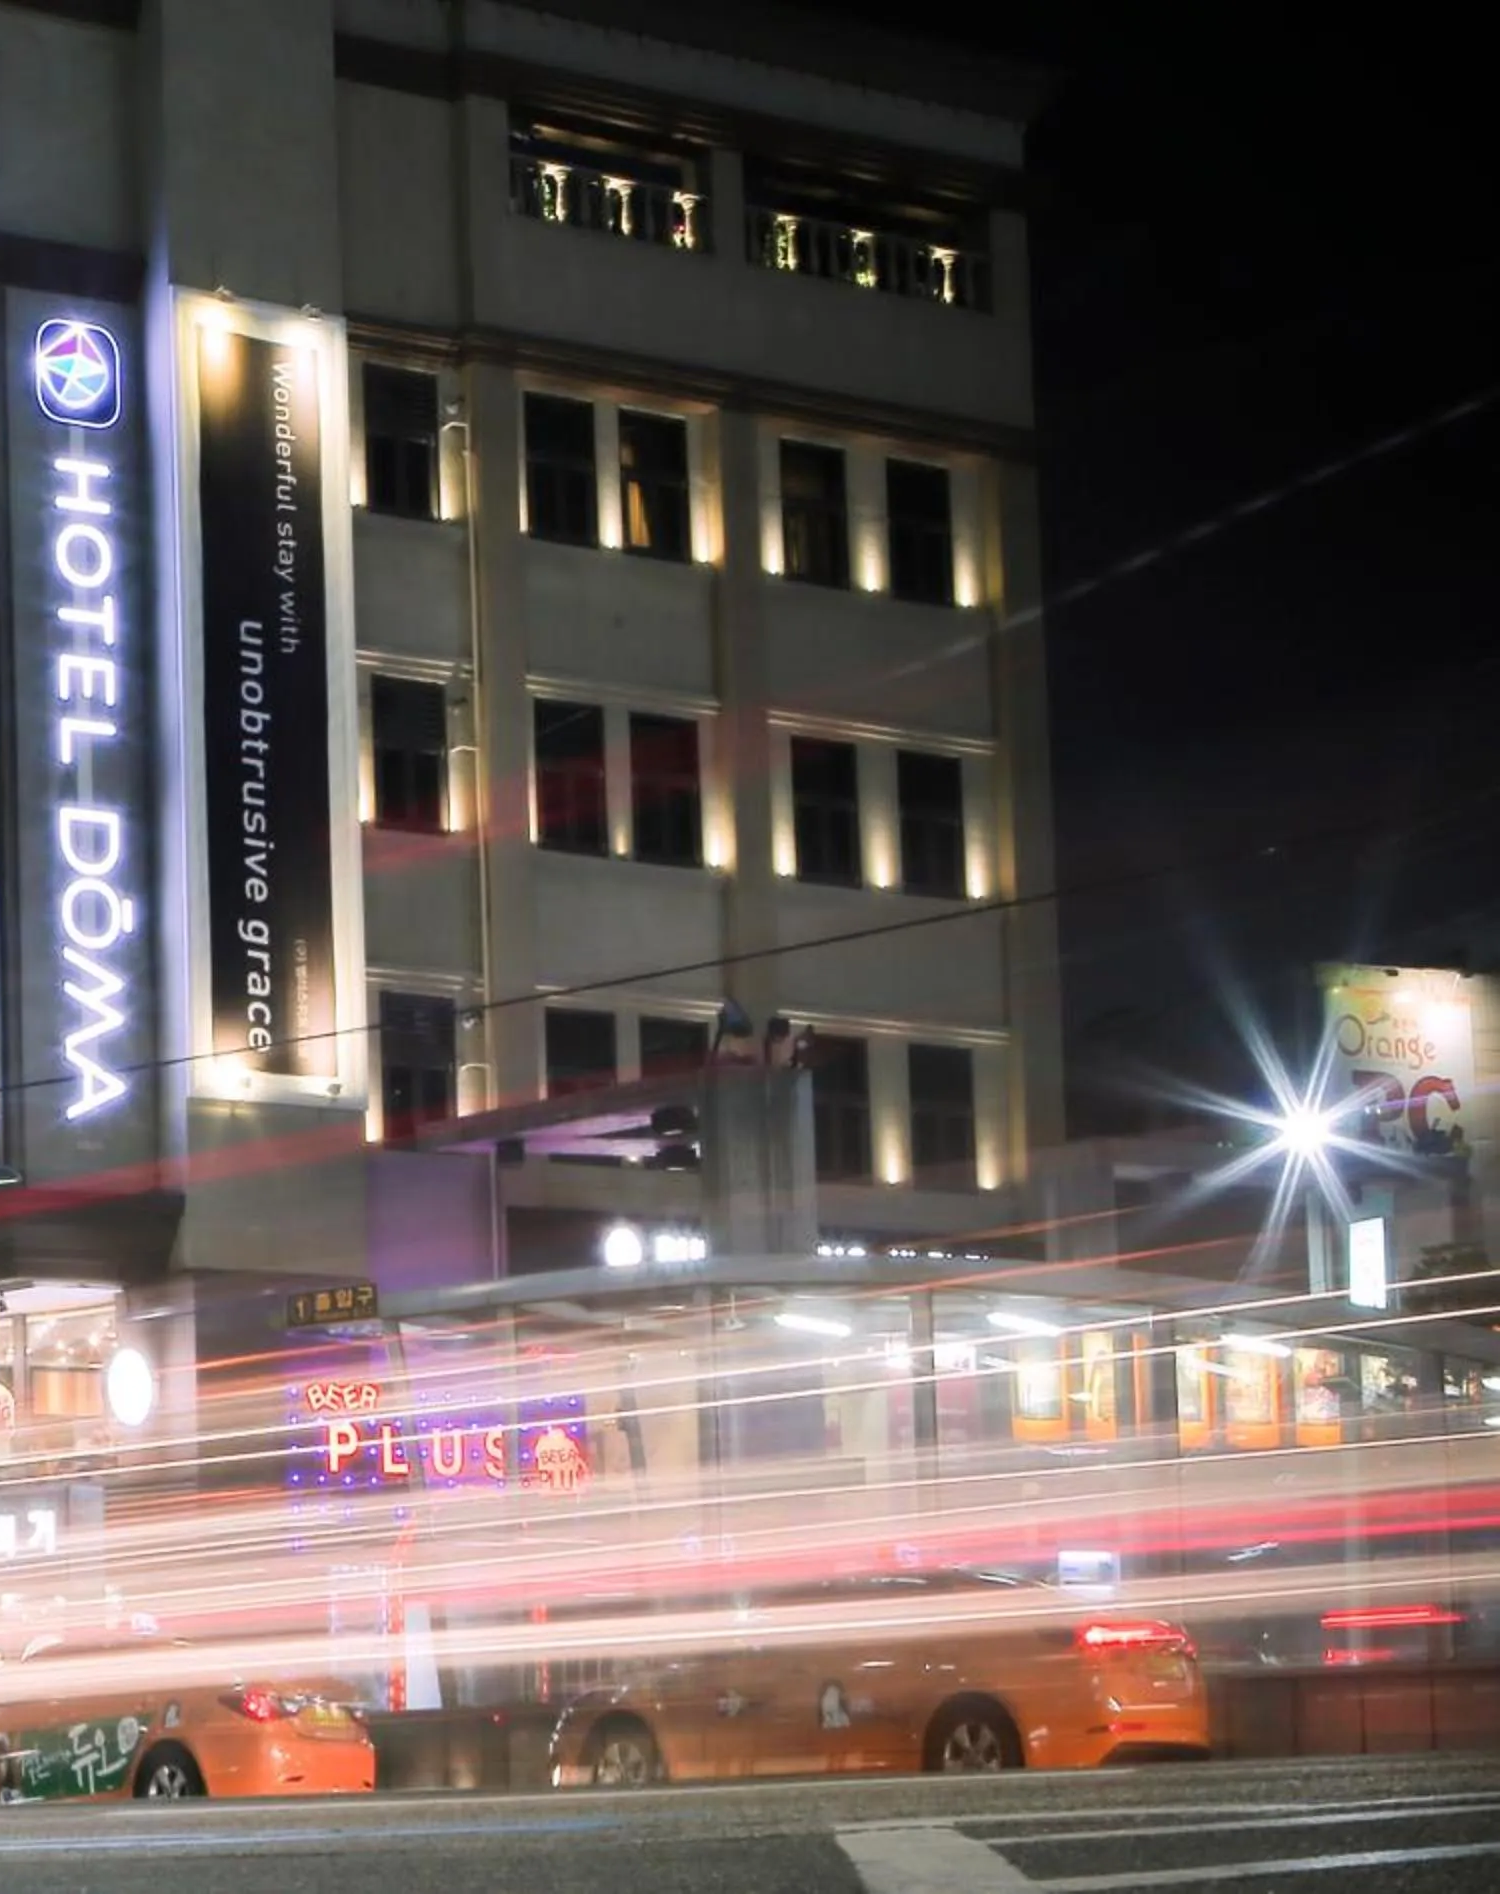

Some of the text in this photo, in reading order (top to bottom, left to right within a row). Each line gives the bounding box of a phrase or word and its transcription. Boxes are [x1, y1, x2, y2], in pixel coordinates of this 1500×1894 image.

[271, 361, 301, 654] Wonderful stay with
[54, 458, 117, 764] HOTEL
[237, 620, 274, 1054] unobtrusive grace
[1335, 1013, 1437, 1070] Orange
[1352, 1069, 1461, 1147] PC
[307, 1382, 379, 1412] BEER
[328, 1421, 505, 1477] PLUS
